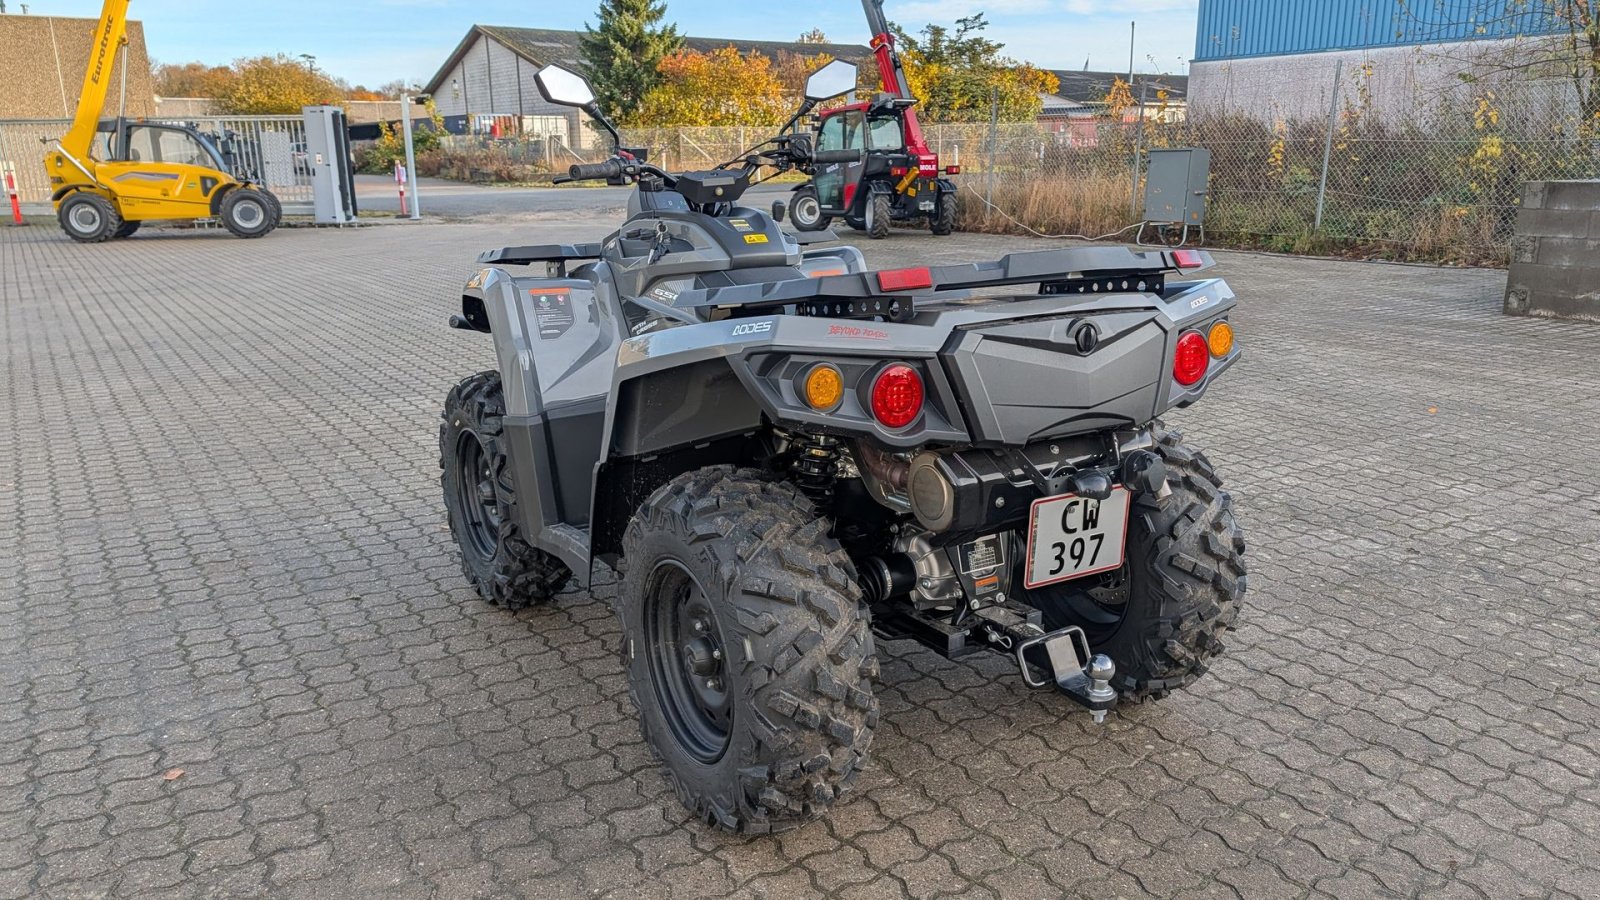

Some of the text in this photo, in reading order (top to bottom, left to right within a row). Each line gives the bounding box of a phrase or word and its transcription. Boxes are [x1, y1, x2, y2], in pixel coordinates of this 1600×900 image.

[91, 15, 113, 85] Eurotrac
[732, 321, 773, 336] AODES
[1061, 499, 1101, 534] CW
[1049, 533, 1105, 575] 397
